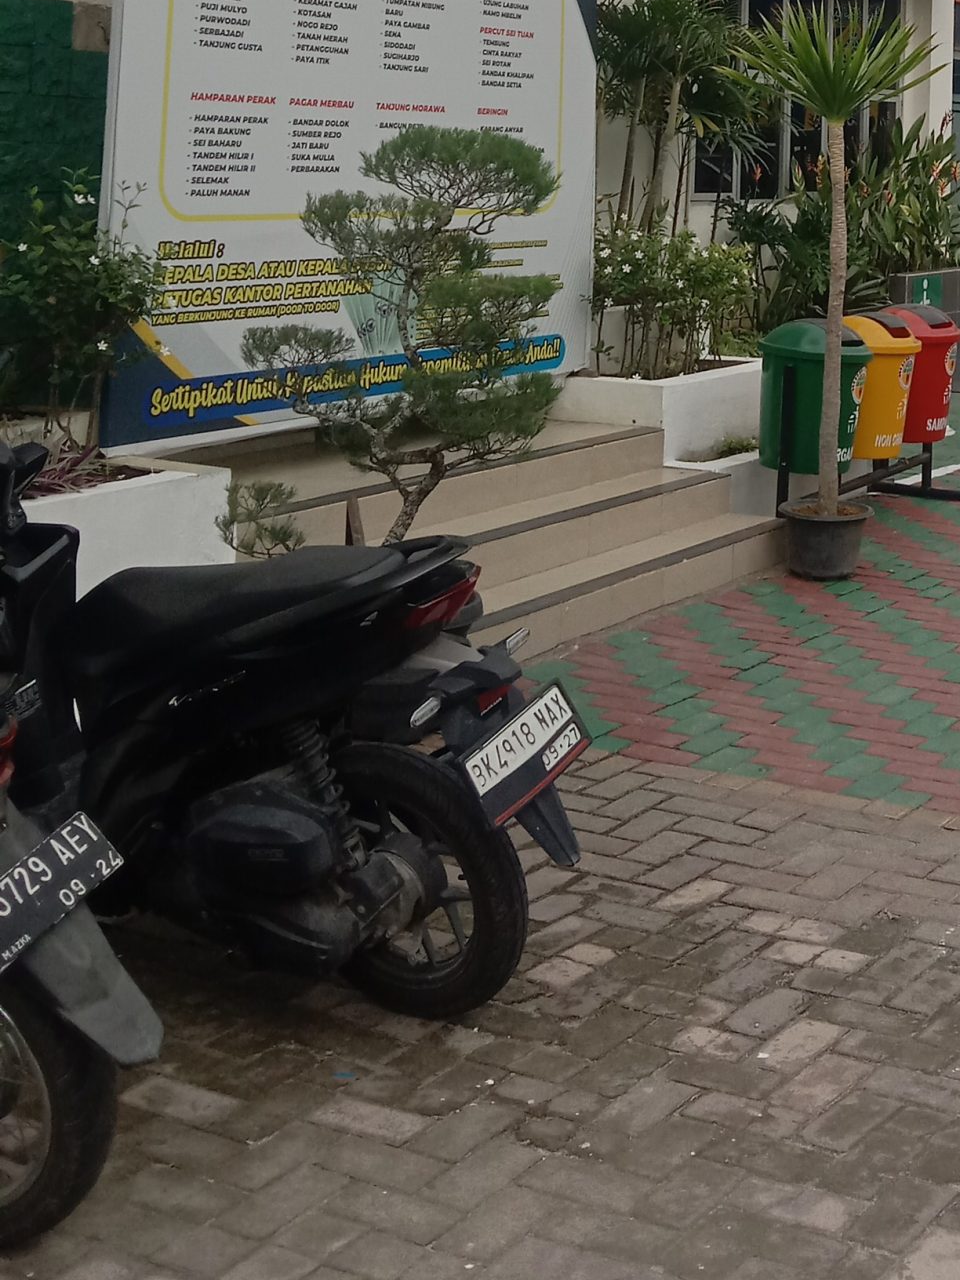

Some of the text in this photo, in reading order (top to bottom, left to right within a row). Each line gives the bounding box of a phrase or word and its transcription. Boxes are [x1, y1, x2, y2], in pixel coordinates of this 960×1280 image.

[201, 2, 248, 14] PUJI MULYO
[200, 15, 250, 26] PURWODADI
[199, 27, 244, 38] SERBAJADI
[199, 40, 262, 52] TANJUNG GUSTA
[191, 92, 276, 105] HAMPARAN PERAK
[289, 98, 354, 108] PAGAR MERBAU
[376, 102, 445, 113] TANJUNG MORAWA
[194, 114, 241, 123] HAMPARAN
[193, 127, 215, 135] PAYA
[192, 152, 227, 160] TANDEM
[229, 152, 249, 160] HILIR
[220, 189, 250, 197] MANAN
[163, 265, 214, 286] EPALA
[216, 262, 256, 282] DESA
[258, 260, 296, 281] ATAU
[299, 259, 348, 277] KEPALA
[224, 284, 282, 304] KANTOR
[284, 278, 374, 301] PERTANAHAN
[151, 313, 176, 326] YANG
[177, 309, 233, 324] BERKUNJUNG
[235, 308, 247, 319] KE
[247, 306, 276, 318] RUMAH
[304, 303, 314, 314] TO
[150, 378, 235, 417] Sertipikat
[236, 376, 281, 401] Untu
[525, 338, 561, 363] Anda!!
[495, 722, 536, 769] 4918
[533, 693, 568, 731] NAX
[50, 815, 98, 865] AEY
